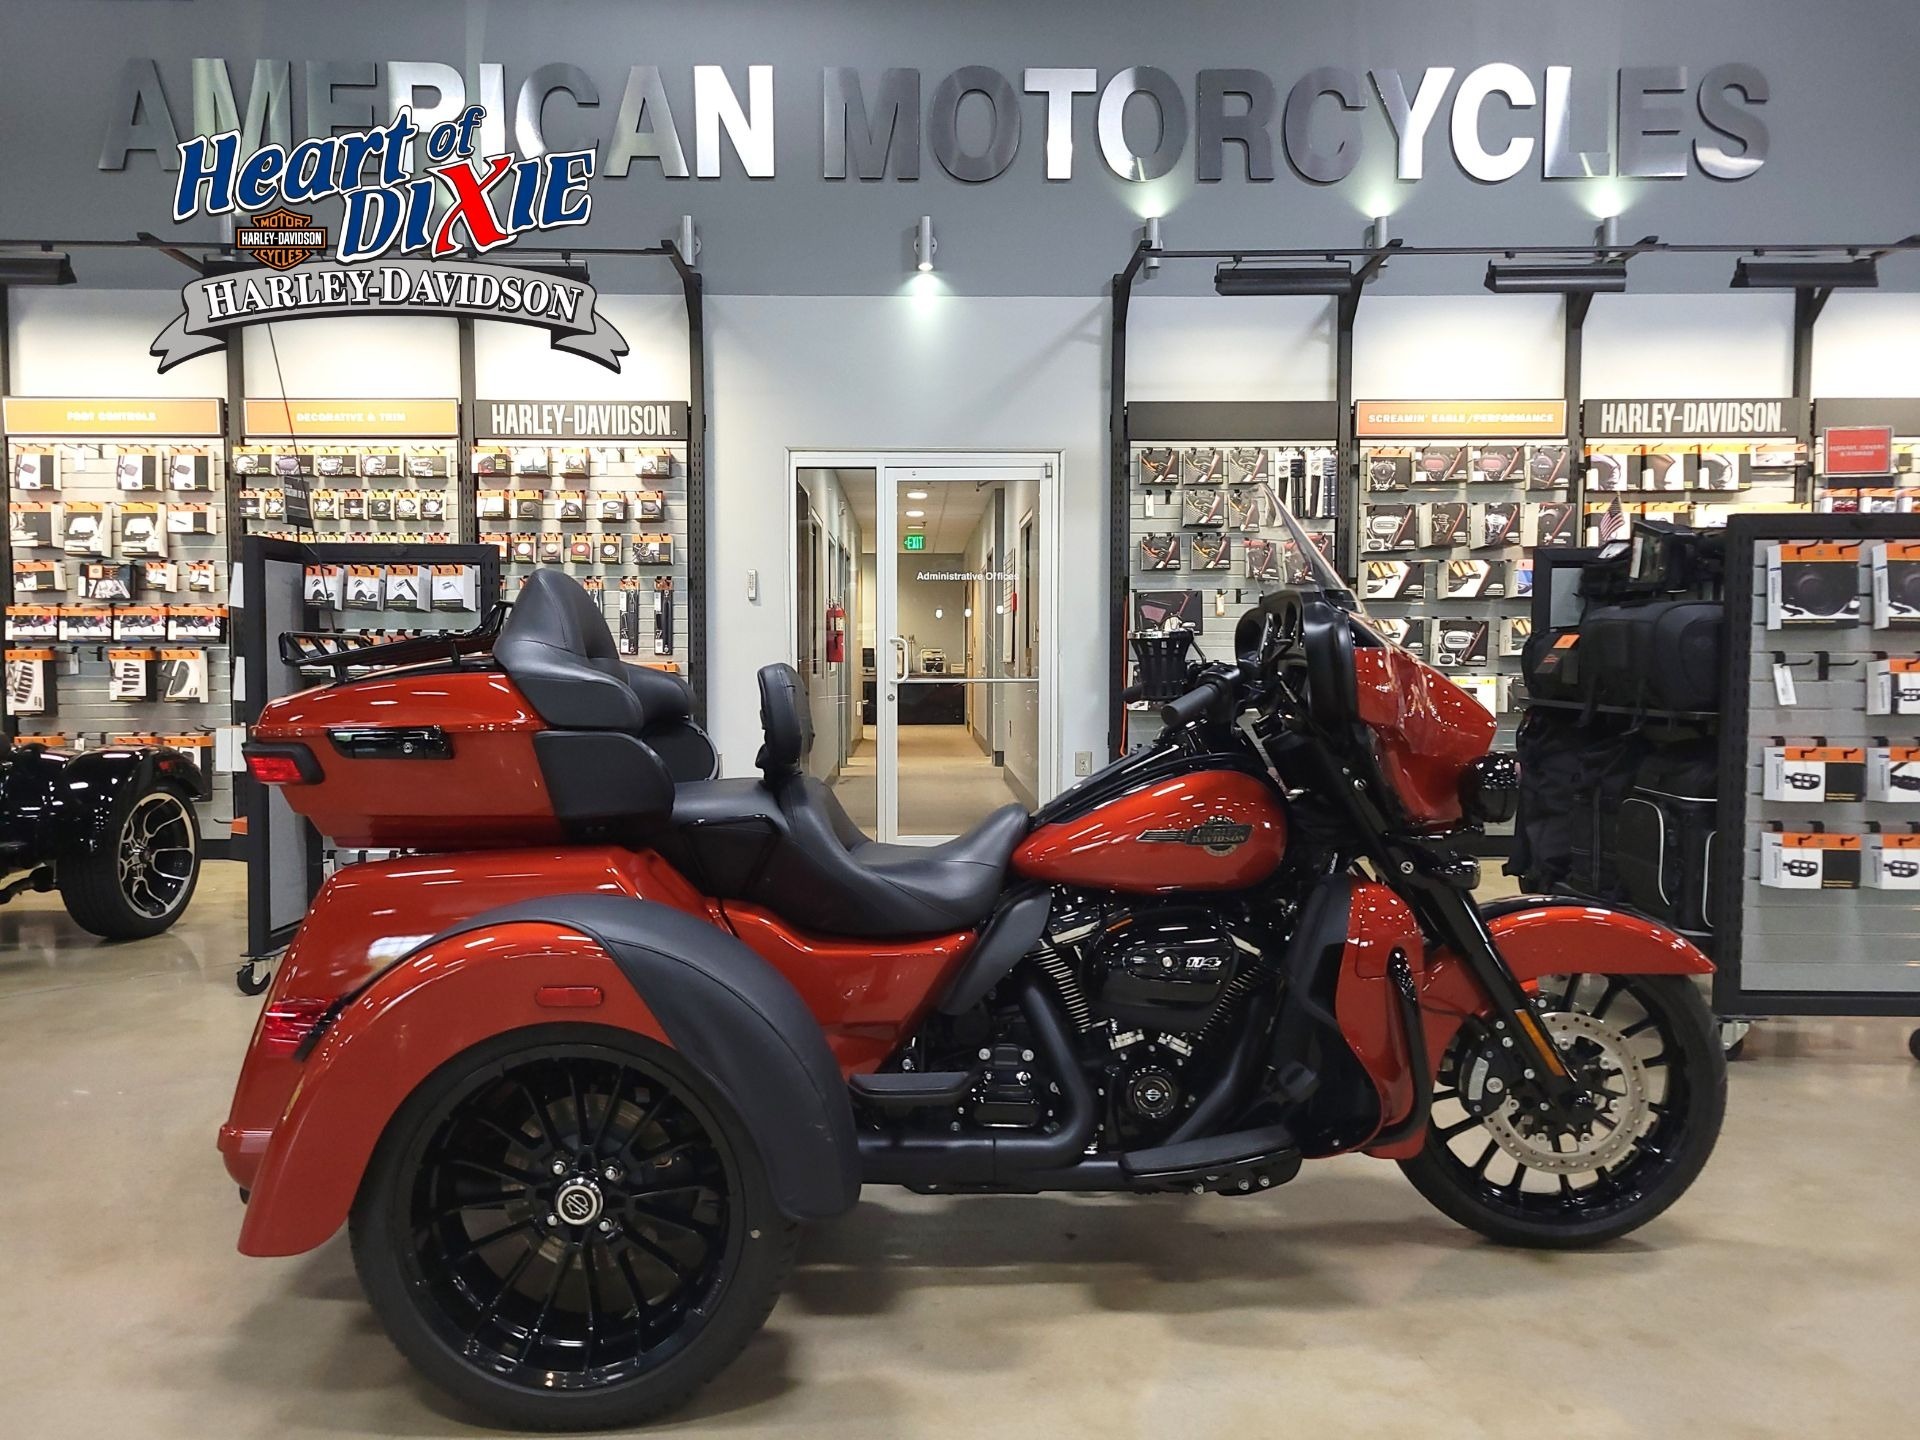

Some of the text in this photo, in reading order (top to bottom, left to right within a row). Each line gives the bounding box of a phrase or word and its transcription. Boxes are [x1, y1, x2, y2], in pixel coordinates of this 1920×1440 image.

[822, 62, 1770, 181] MOTORCYCLES
[296, 412, 364, 422] DECORATIVE
[491, 403, 671, 436] HARLEY-DAVIDSON
[1368, 414, 1428, 423] SCREAMIN'
[1600, 401, 1784, 434] HARLEY-DAVIDSON
[907, 536, 924, 550] EXIT
[916, 571, 1020, 581] Administrative Offices
